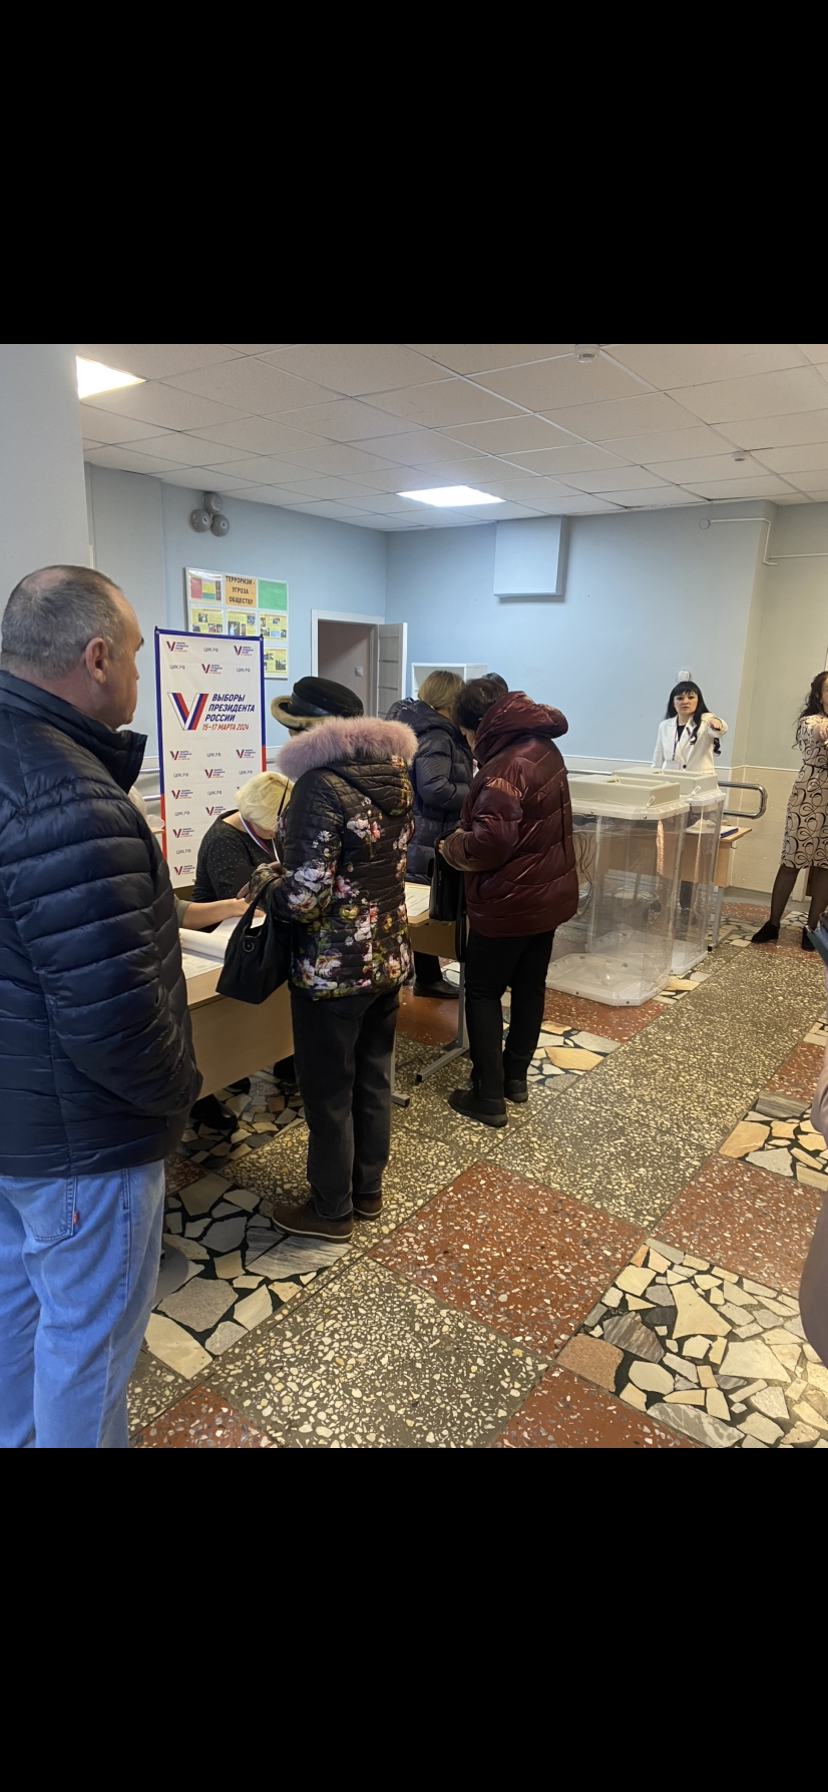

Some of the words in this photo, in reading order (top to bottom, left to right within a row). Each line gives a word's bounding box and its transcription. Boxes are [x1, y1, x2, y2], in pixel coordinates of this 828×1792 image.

[225, 575, 253, 585] ТЕРРОРИЗМ
[229, 596, 253, 605] ОБЩЕСТВУ
[212, 693, 246, 702] ВЫБОРЫ
[208, 704, 255, 713] ПРЕЗИДЕНТА
[205, 714, 236, 722] РОССИИ
